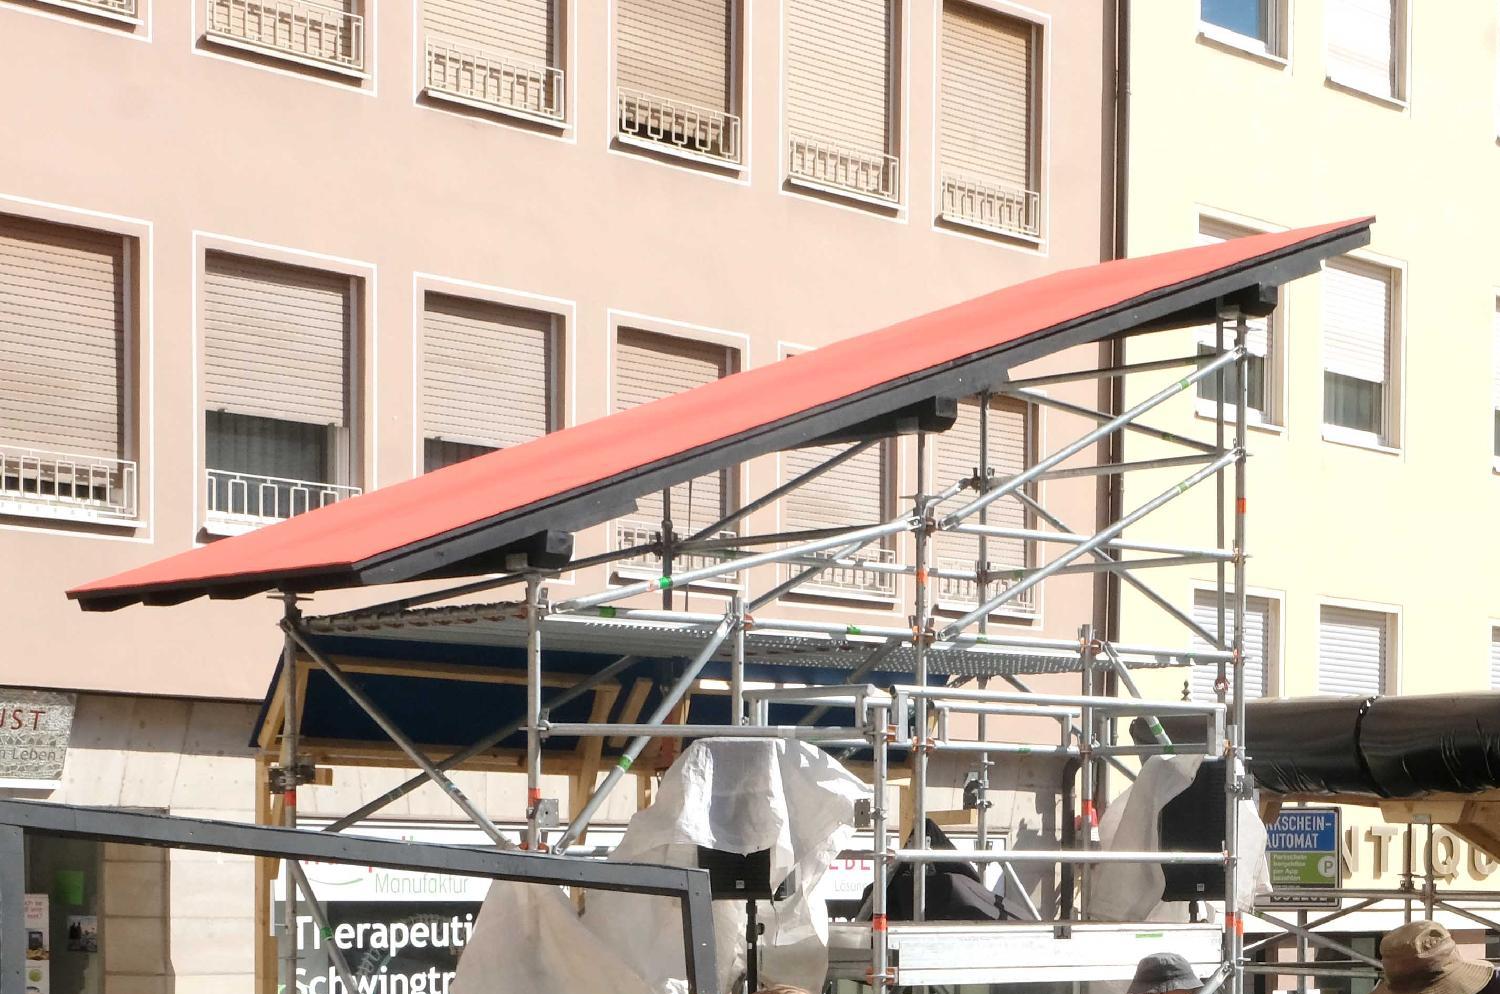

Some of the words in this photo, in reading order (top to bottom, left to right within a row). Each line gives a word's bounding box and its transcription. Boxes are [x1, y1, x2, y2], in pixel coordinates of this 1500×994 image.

[12, 747, 56, 760] Leben
[1266, 833, 1319, 848] AUTOMAT
[1324, 861, 1334, 874] P
[374, 873, 469, 894] Manufaktur
